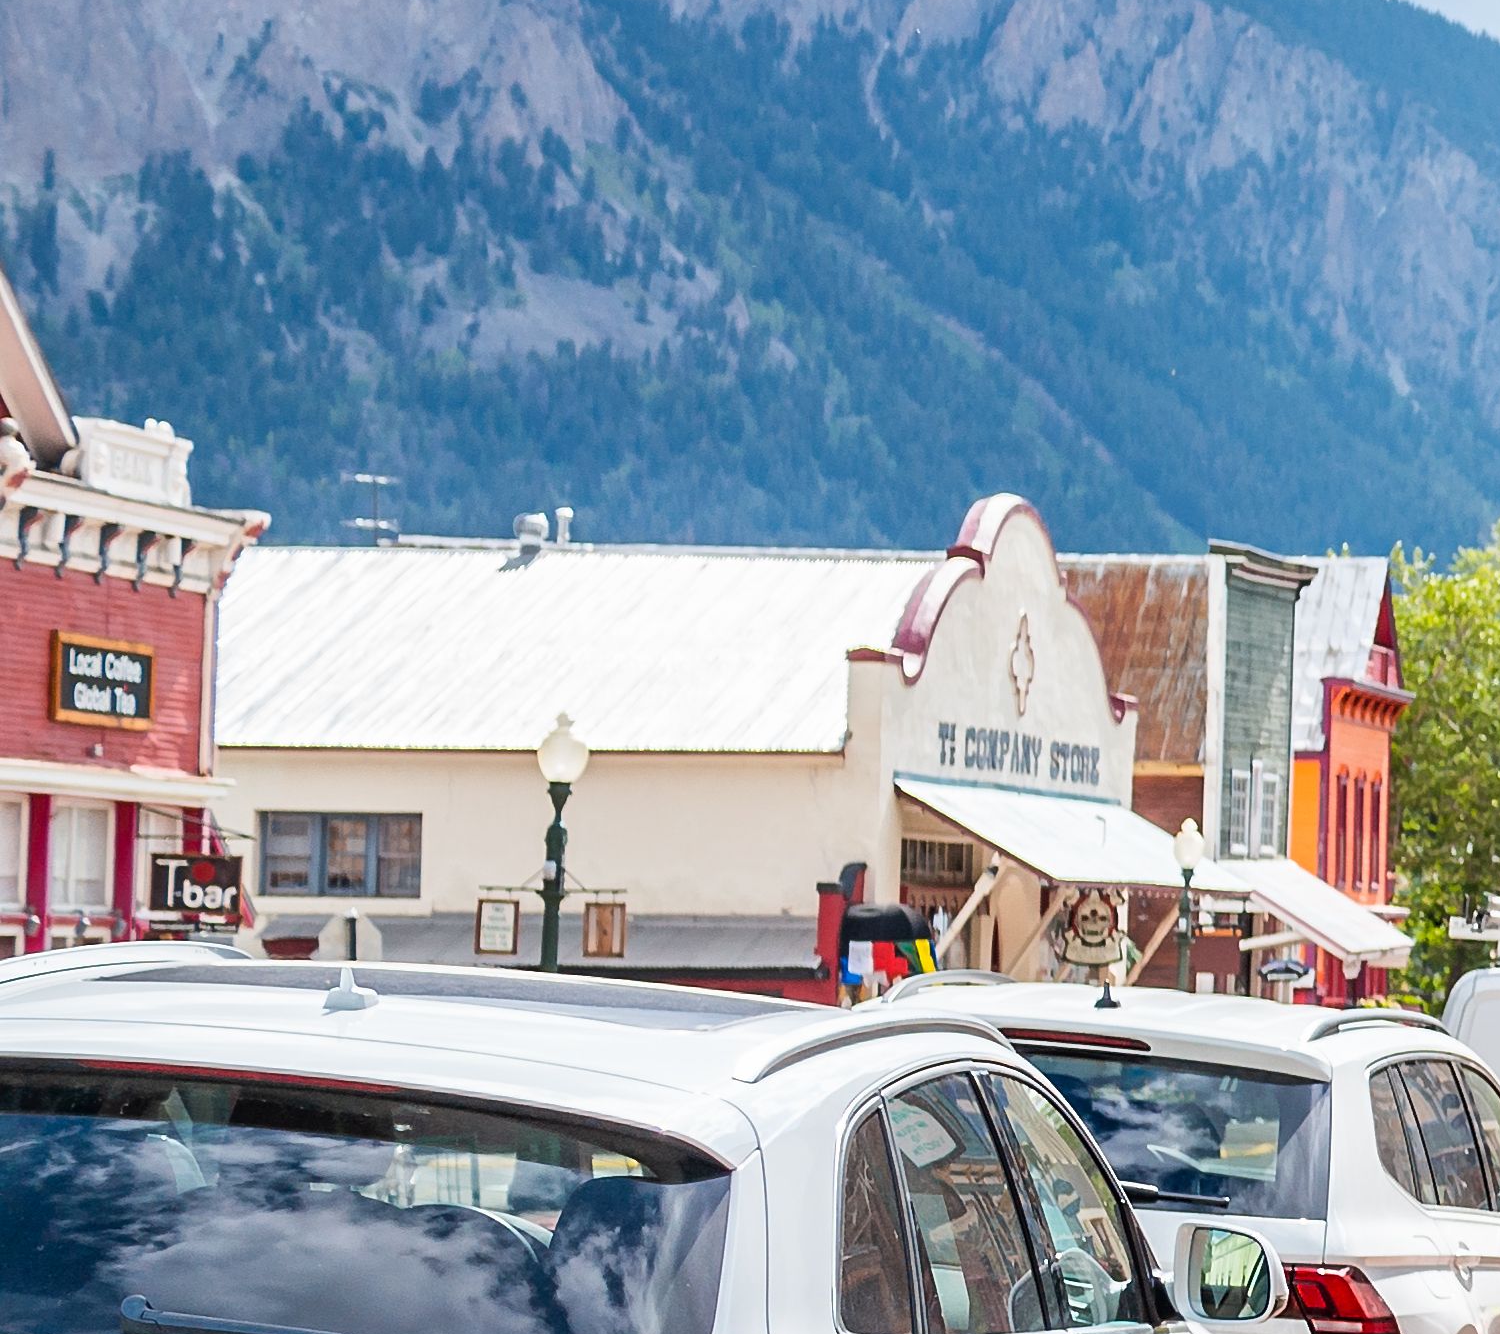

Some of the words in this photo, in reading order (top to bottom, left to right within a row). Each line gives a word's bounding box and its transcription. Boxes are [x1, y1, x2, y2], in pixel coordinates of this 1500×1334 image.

[69, 647, 103, 679] Local
[105, 652, 142, 684] Coffee
[74, 682, 112, 713] Global
[964, 726, 1043, 778] COMPANY
[1049, 740, 1101, 786] STORE
